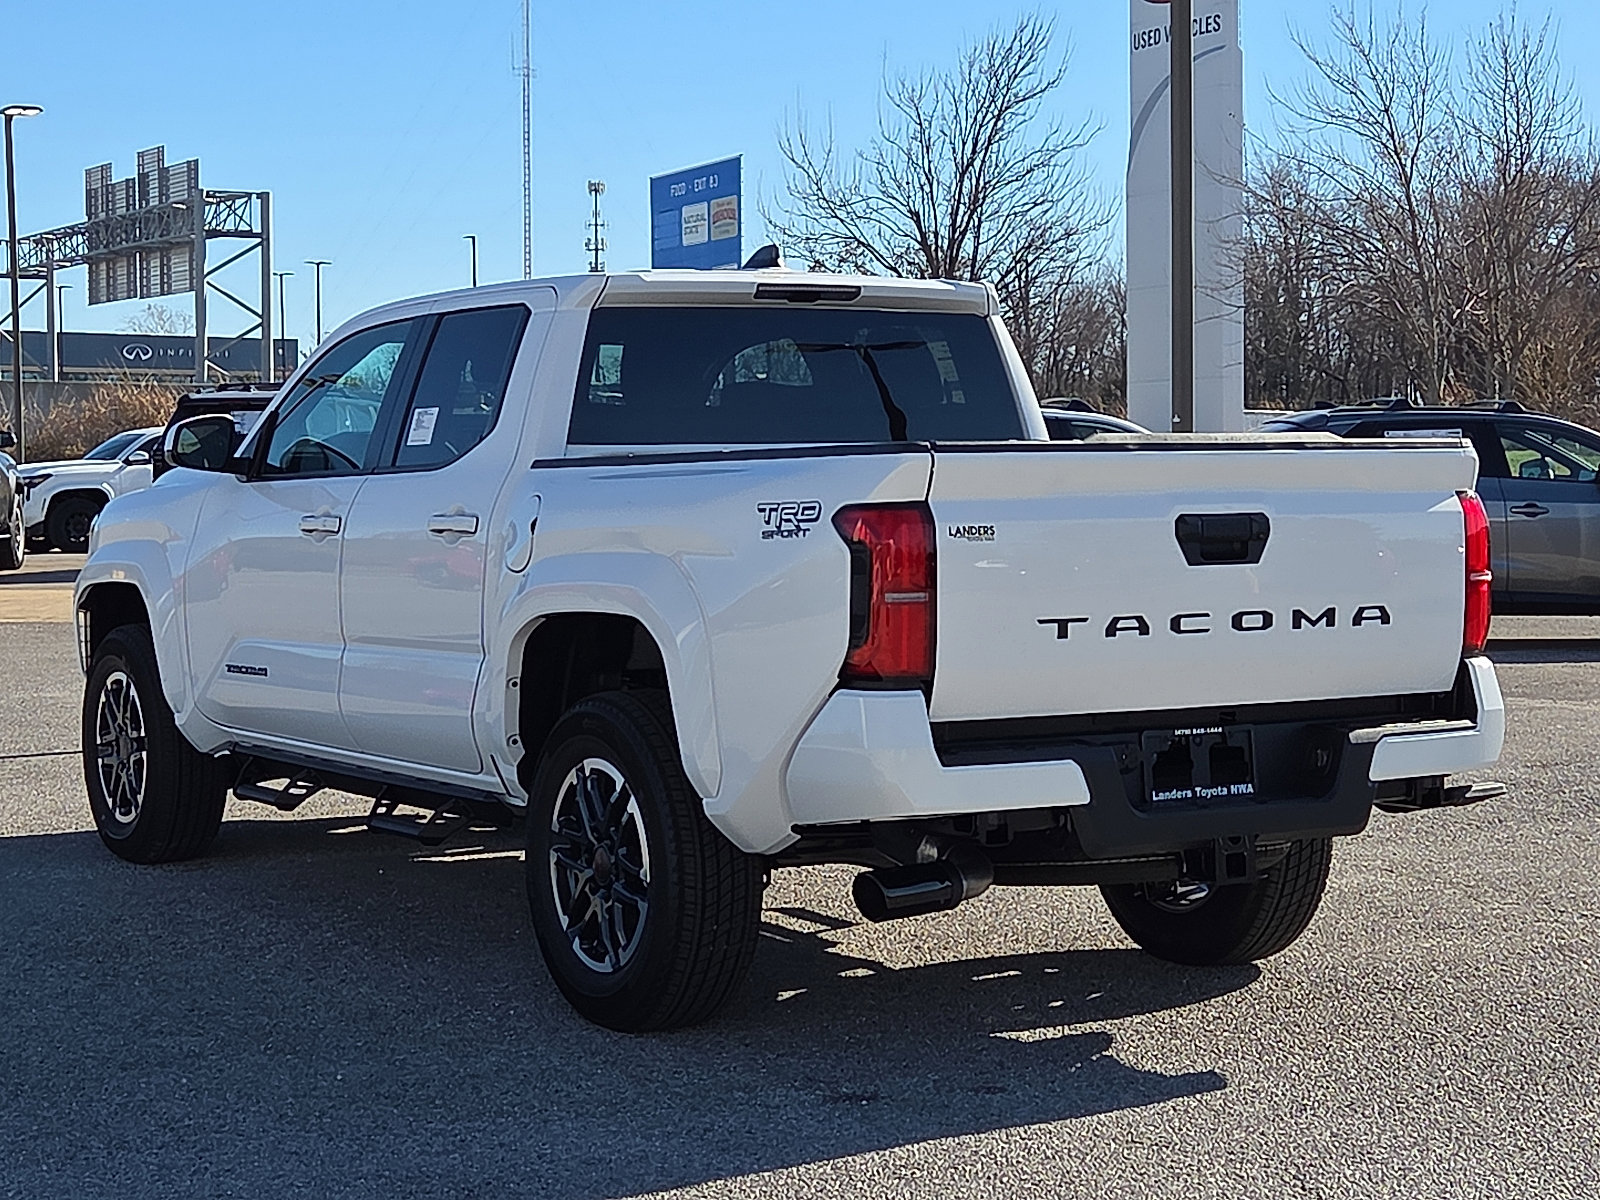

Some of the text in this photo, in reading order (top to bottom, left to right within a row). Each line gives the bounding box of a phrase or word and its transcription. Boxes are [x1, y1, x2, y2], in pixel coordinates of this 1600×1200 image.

[1133, 14, 1221, 50] USED VCLES
[670, 182, 687, 197] FOOD
[694, 176, 707, 192] EXIT
[757, 500, 822, 529] TRD
[761, 528, 811, 540] SPORT
[948, 525, 996, 538] LANDERS
[1036, 604, 1392, 640] TACOMA
[1152, 783, 1254, 801] Landers Toyota NWA
